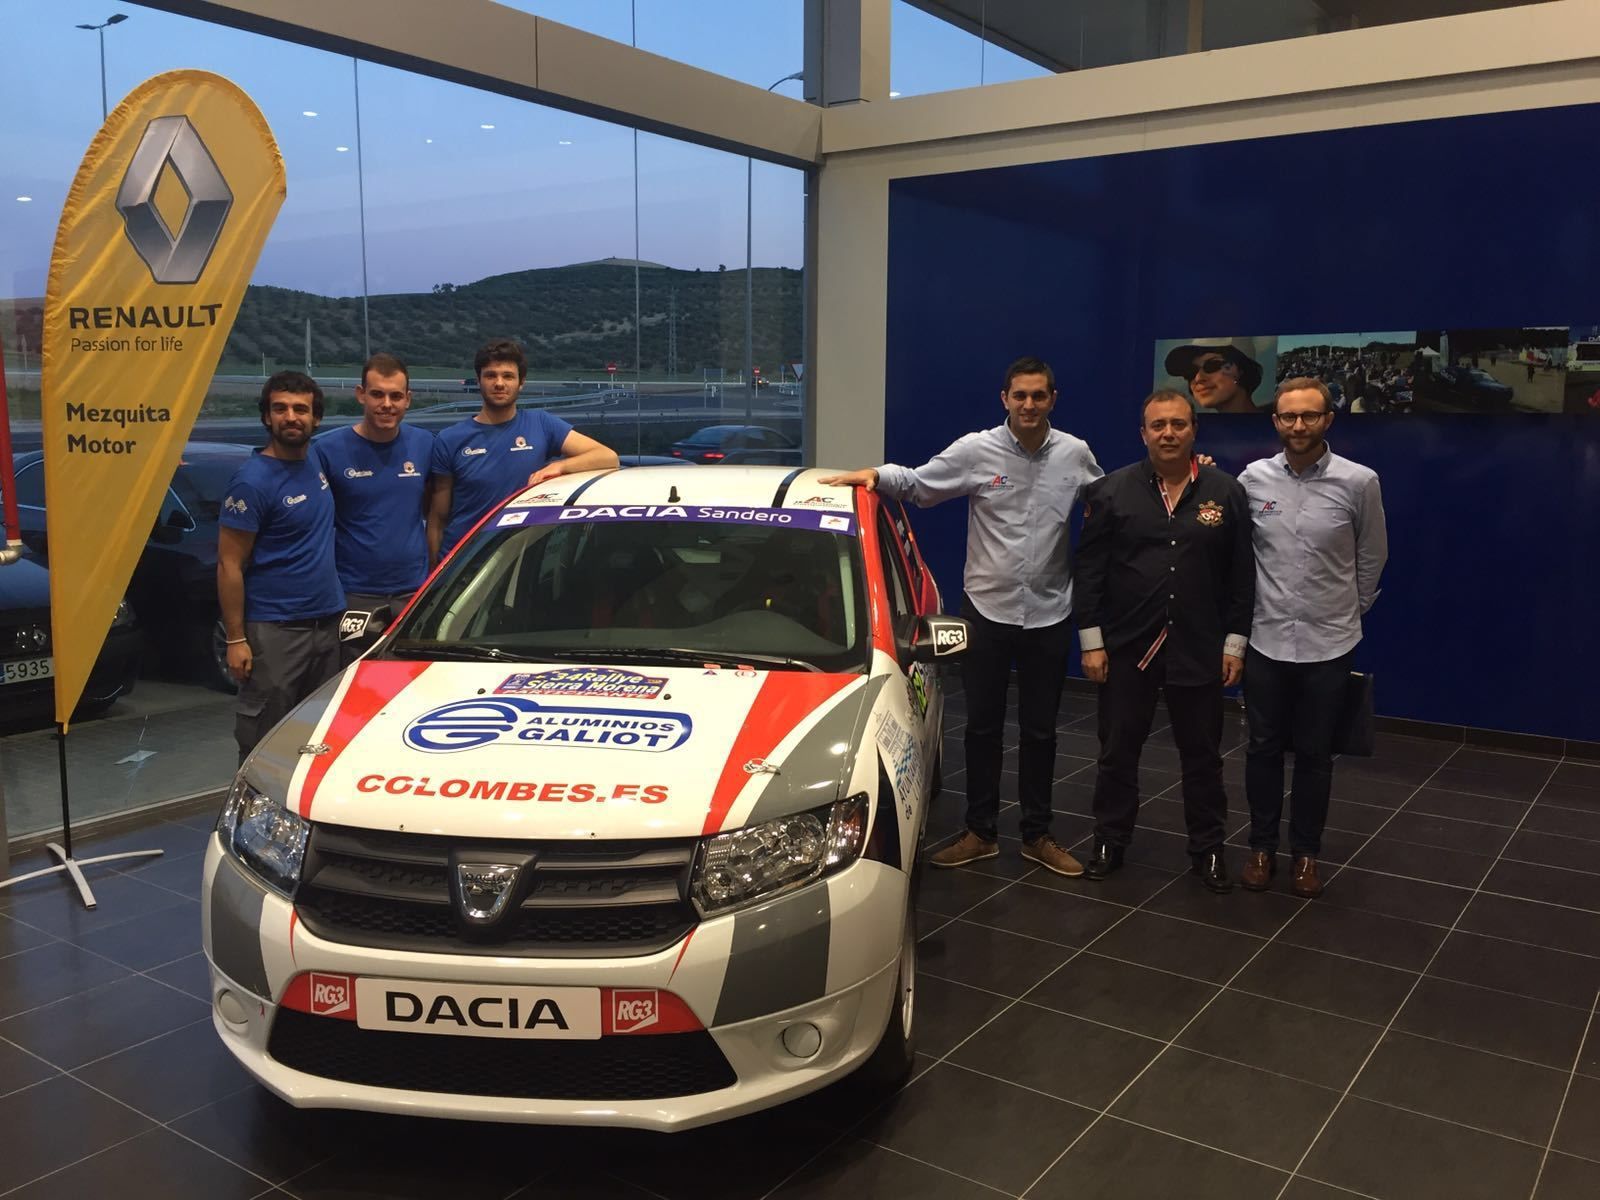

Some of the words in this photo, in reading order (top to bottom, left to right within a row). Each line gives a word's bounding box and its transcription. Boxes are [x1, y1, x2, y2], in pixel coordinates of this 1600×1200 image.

[69, 303, 223, 329] RENAULT
[71, 337, 130, 352] Passion
[135, 336, 157, 351] for
[161, 336, 183, 351] life
[66, 402, 171, 429] Mezquita
[67, 434, 137, 454] Motor
[558, 506, 688, 520] DACIA
[697, 507, 792, 523] Sandero
[341, 617, 364, 633] RG3
[937, 629, 964, 646] RG3
[5, 660, 50, 680] 5935
[523, 679, 583, 691] Sierra
[585, 681, 661, 694] Morena
[526, 716, 675, 732] ALUMINIOS
[517, 727, 669, 747] GALIOT
[356, 774, 670, 804] COLOMBES.ES
[314, 982, 345, 1005] RG3
[385, 990, 570, 1030] DACIA
[617, 999, 654, 1021] RG3
